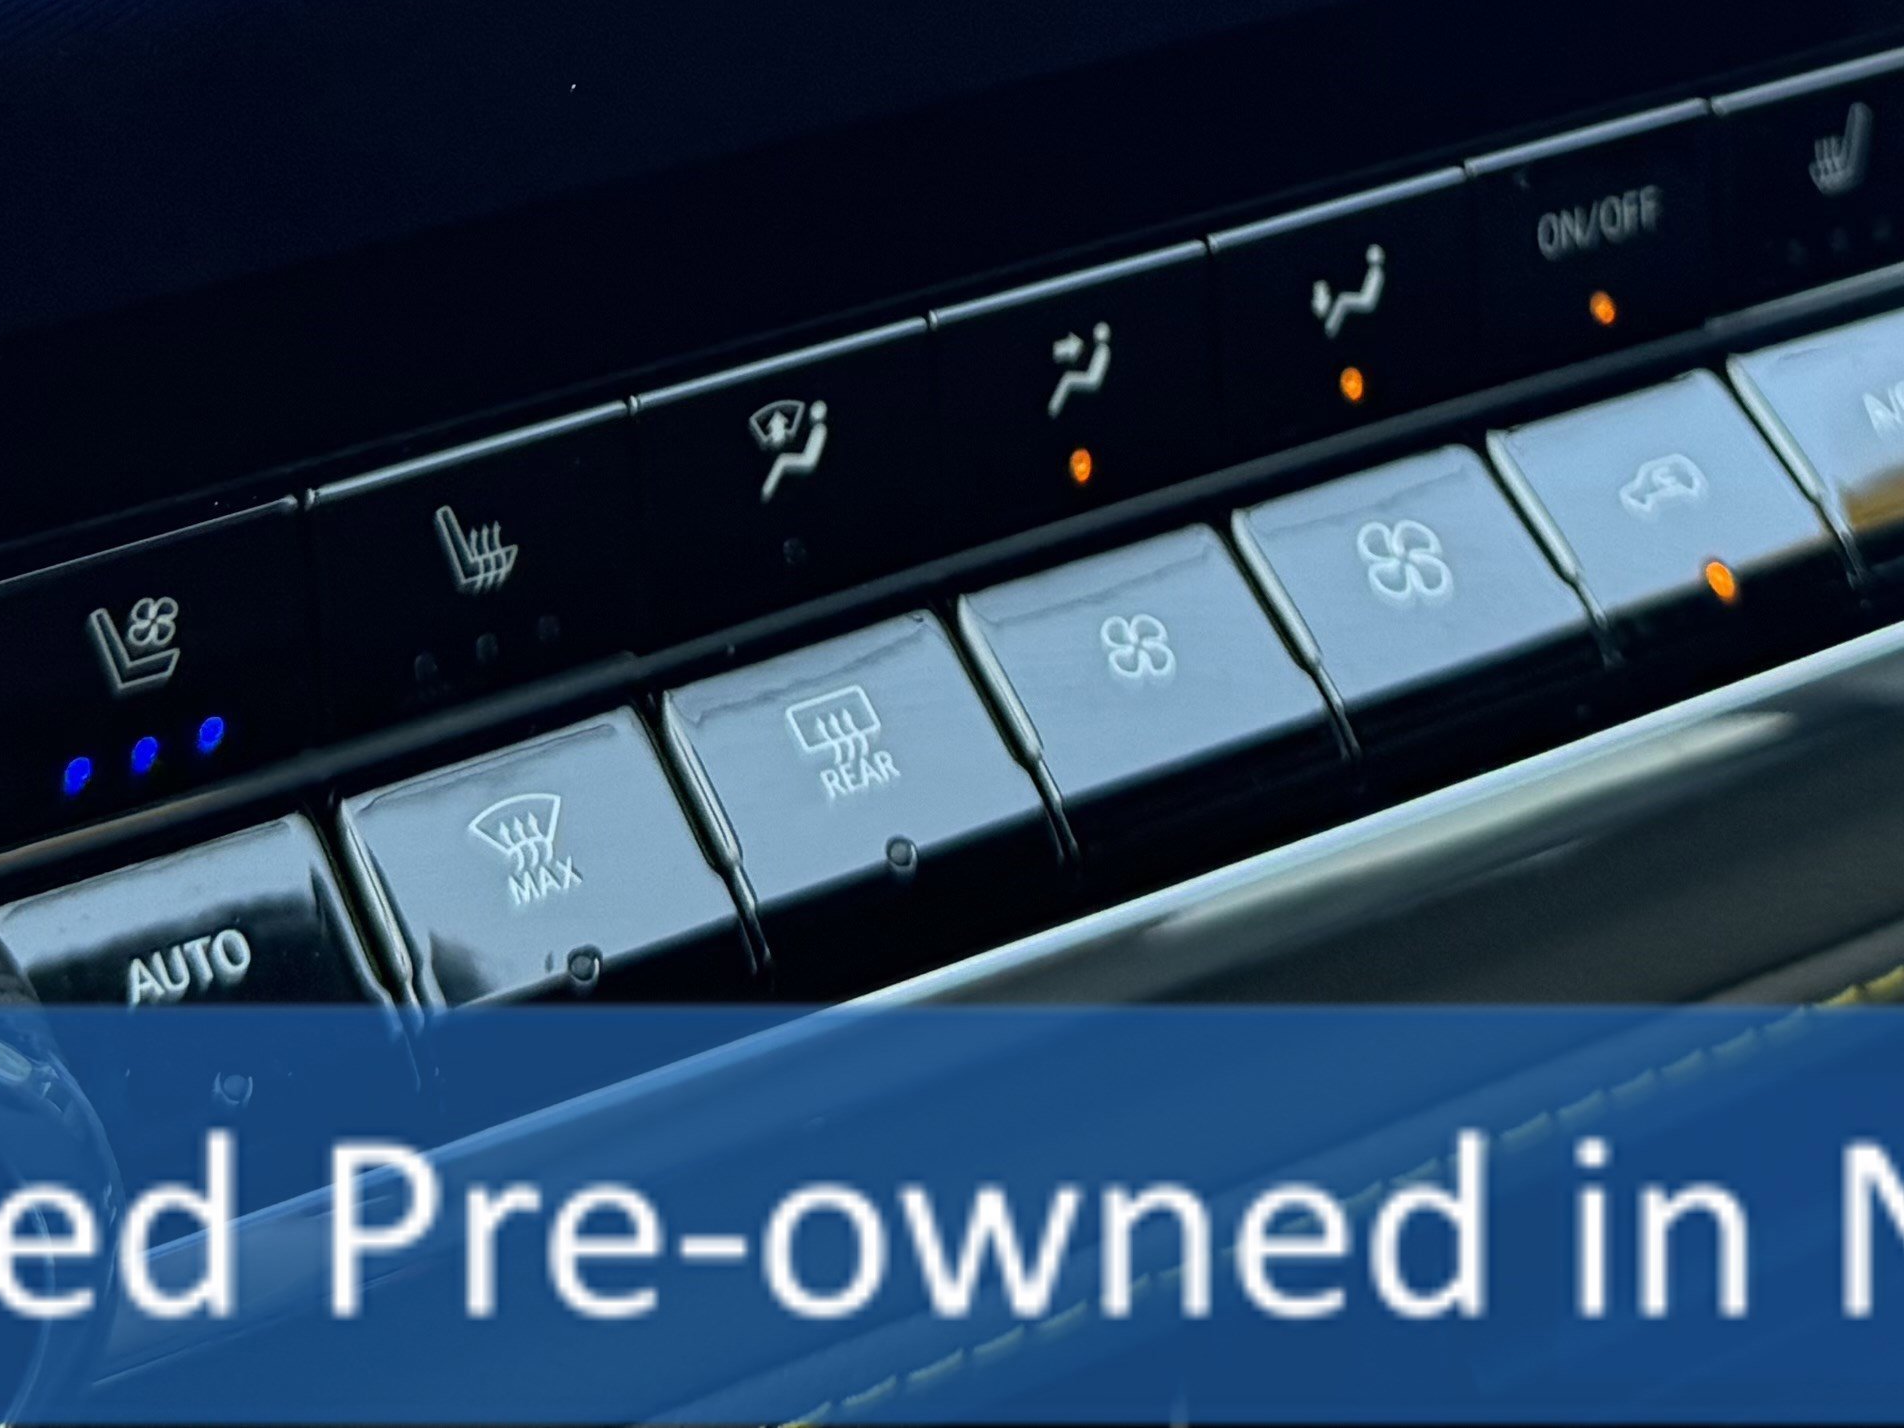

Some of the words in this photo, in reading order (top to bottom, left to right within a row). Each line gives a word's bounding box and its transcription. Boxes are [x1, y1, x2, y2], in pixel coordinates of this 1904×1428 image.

[1537, 185, 1663, 261] ON/OFF
[820, 750, 901, 801] REAR
[508, 856, 584, 908] MAX
[128, 928, 252, 1008] AUTO
